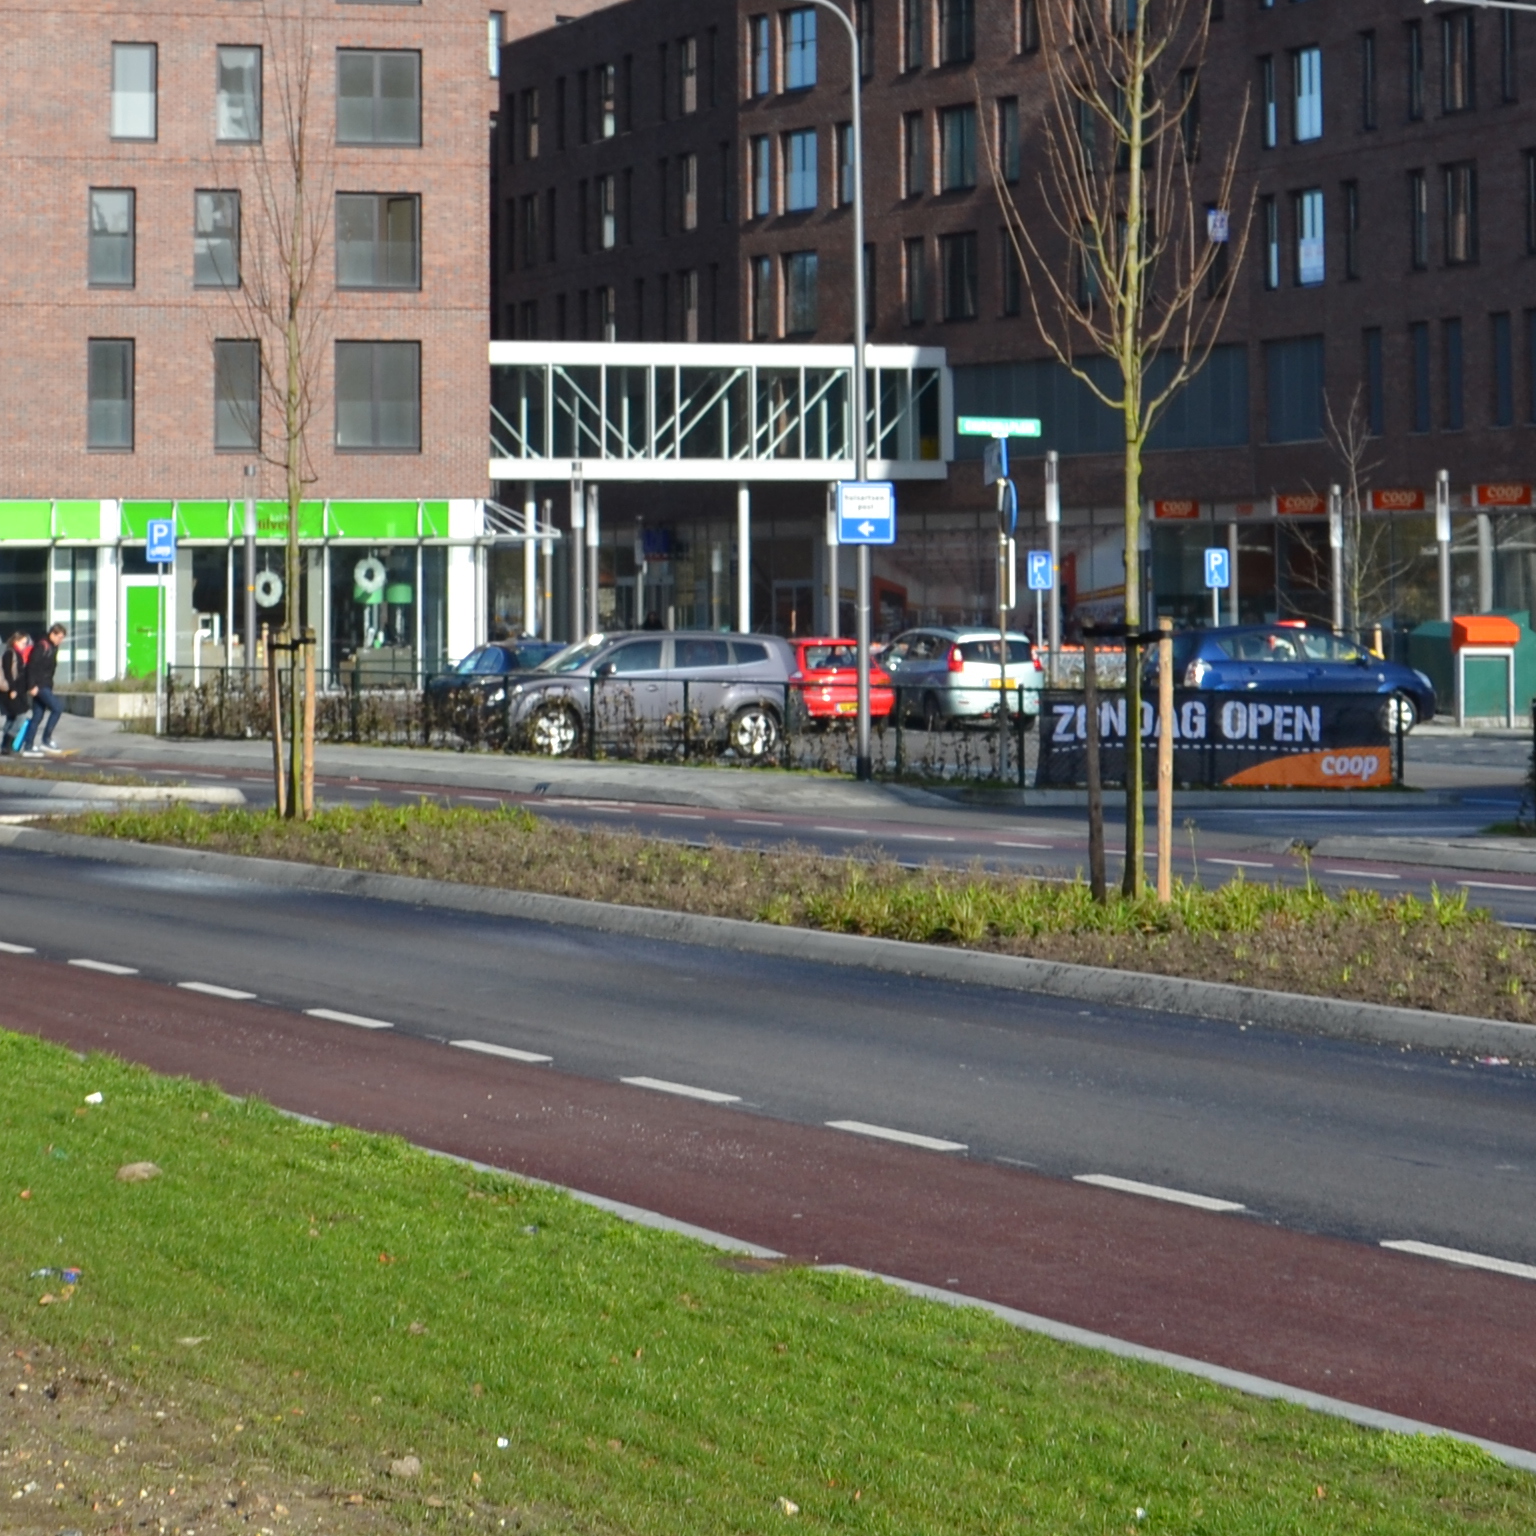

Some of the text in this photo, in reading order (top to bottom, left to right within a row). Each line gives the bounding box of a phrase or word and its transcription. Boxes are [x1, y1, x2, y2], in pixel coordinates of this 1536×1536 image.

[1382, 490, 1416, 505] coop
[1487, 485, 1523, 502] coop
[1162, 500, 1193, 516] coop
[1285, 495, 1319, 511] coop
[153, 524, 168, 544] P
[1033, 555, 1046, 573] P
[1210, 552, 1223, 571] P
[1221, 700, 1321, 742] OPEN
[1321, 755, 1379, 782] coop
